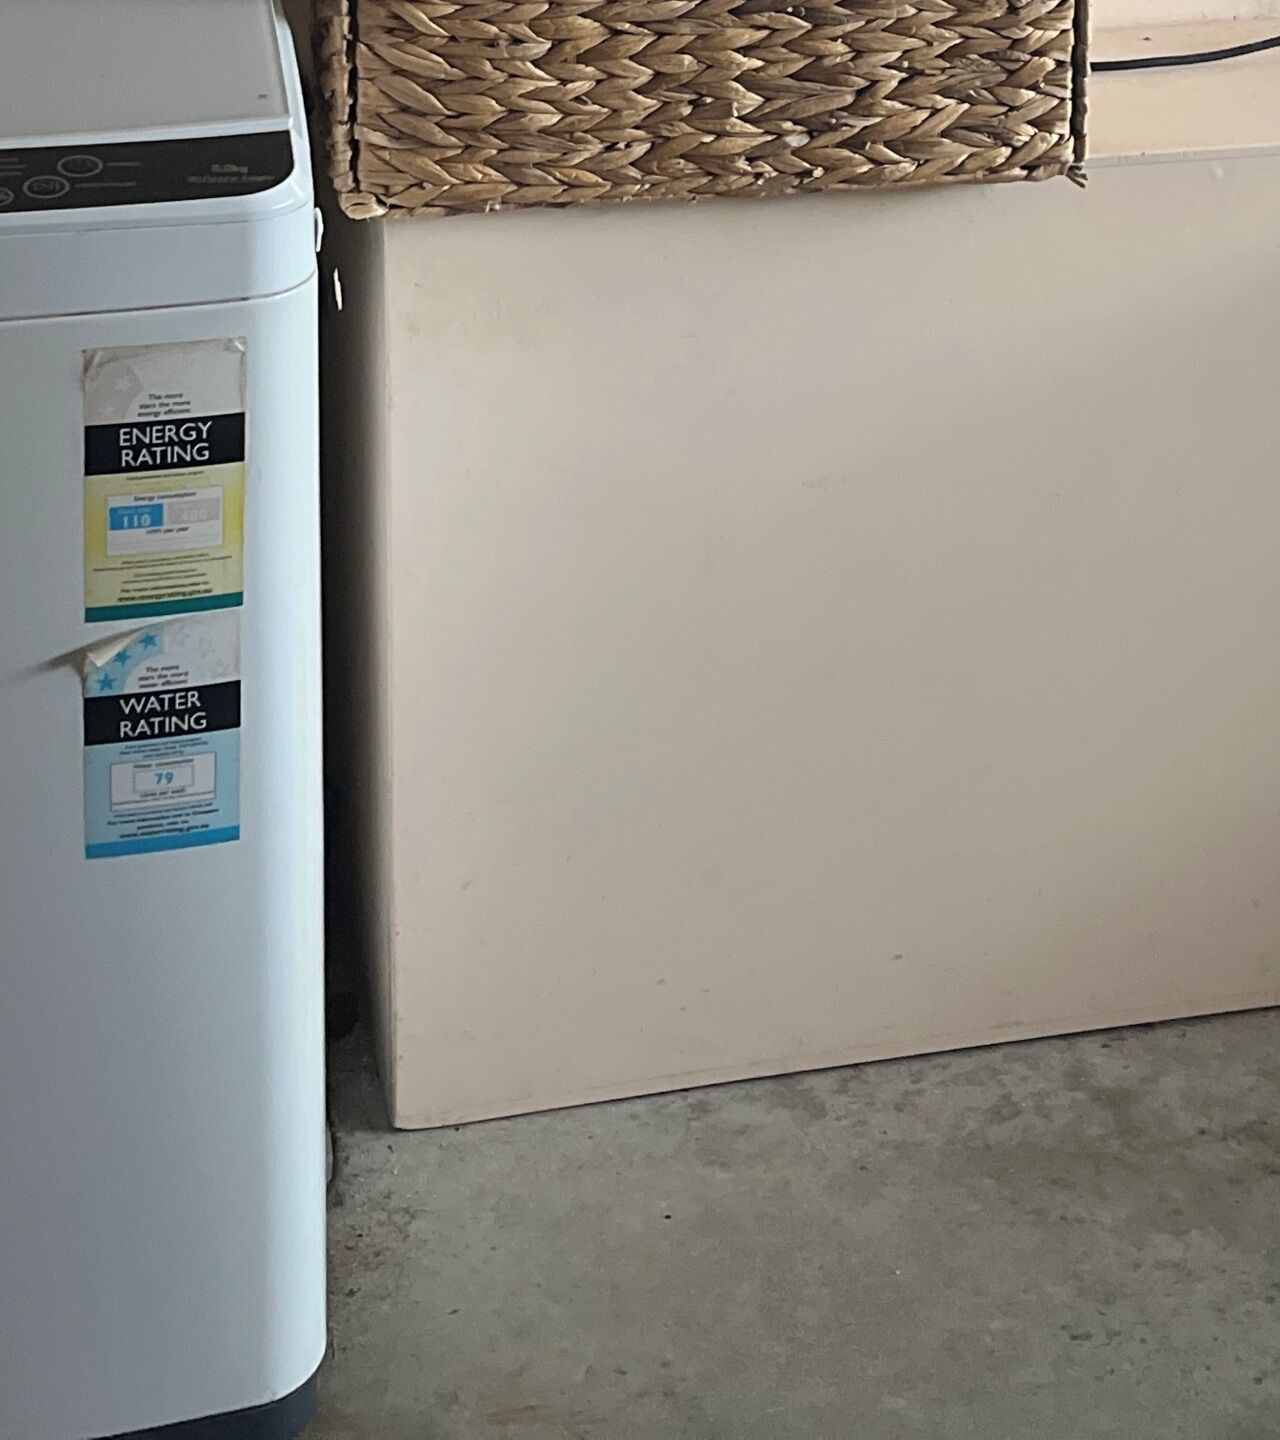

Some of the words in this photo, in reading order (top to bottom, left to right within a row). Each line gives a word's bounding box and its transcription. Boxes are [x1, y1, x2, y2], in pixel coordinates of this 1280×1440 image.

[119, 421, 213, 447] ENERGY
[121, 442, 210, 468] RATING
[120, 690, 201, 715] WATER
[120, 711, 208, 739] RATING
[154, 771, 174, 785] 79
